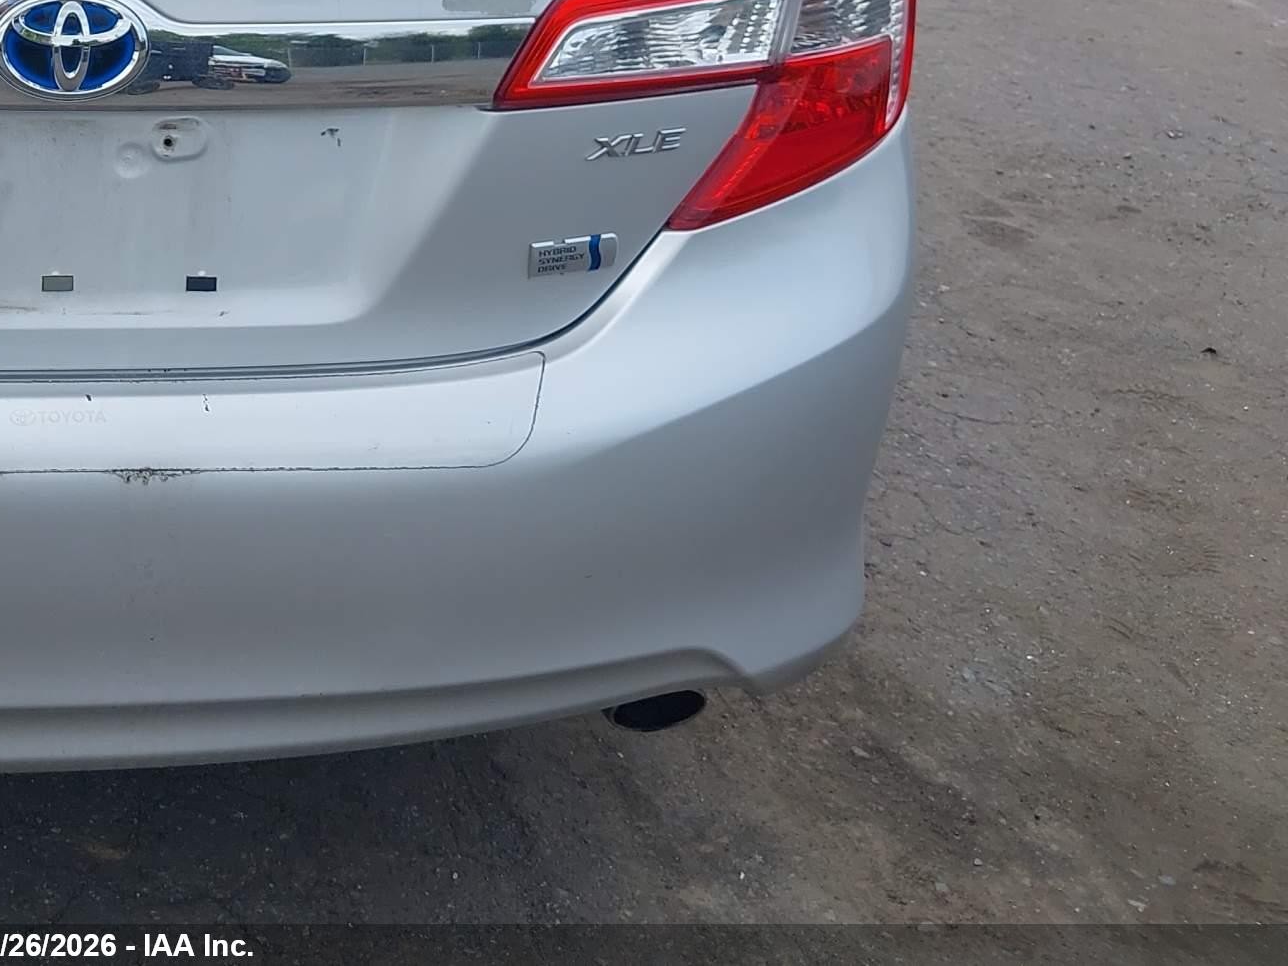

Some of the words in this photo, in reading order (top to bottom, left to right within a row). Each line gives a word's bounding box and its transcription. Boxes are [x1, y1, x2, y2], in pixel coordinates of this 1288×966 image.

[585, 127, 687, 161] XLE
[538, 245, 577, 258] HYBRID
[538, 253, 585, 265] SYNERGY
[537, 263, 568, 273] DRIVE
[37, 410, 109, 424] TOYOTA
